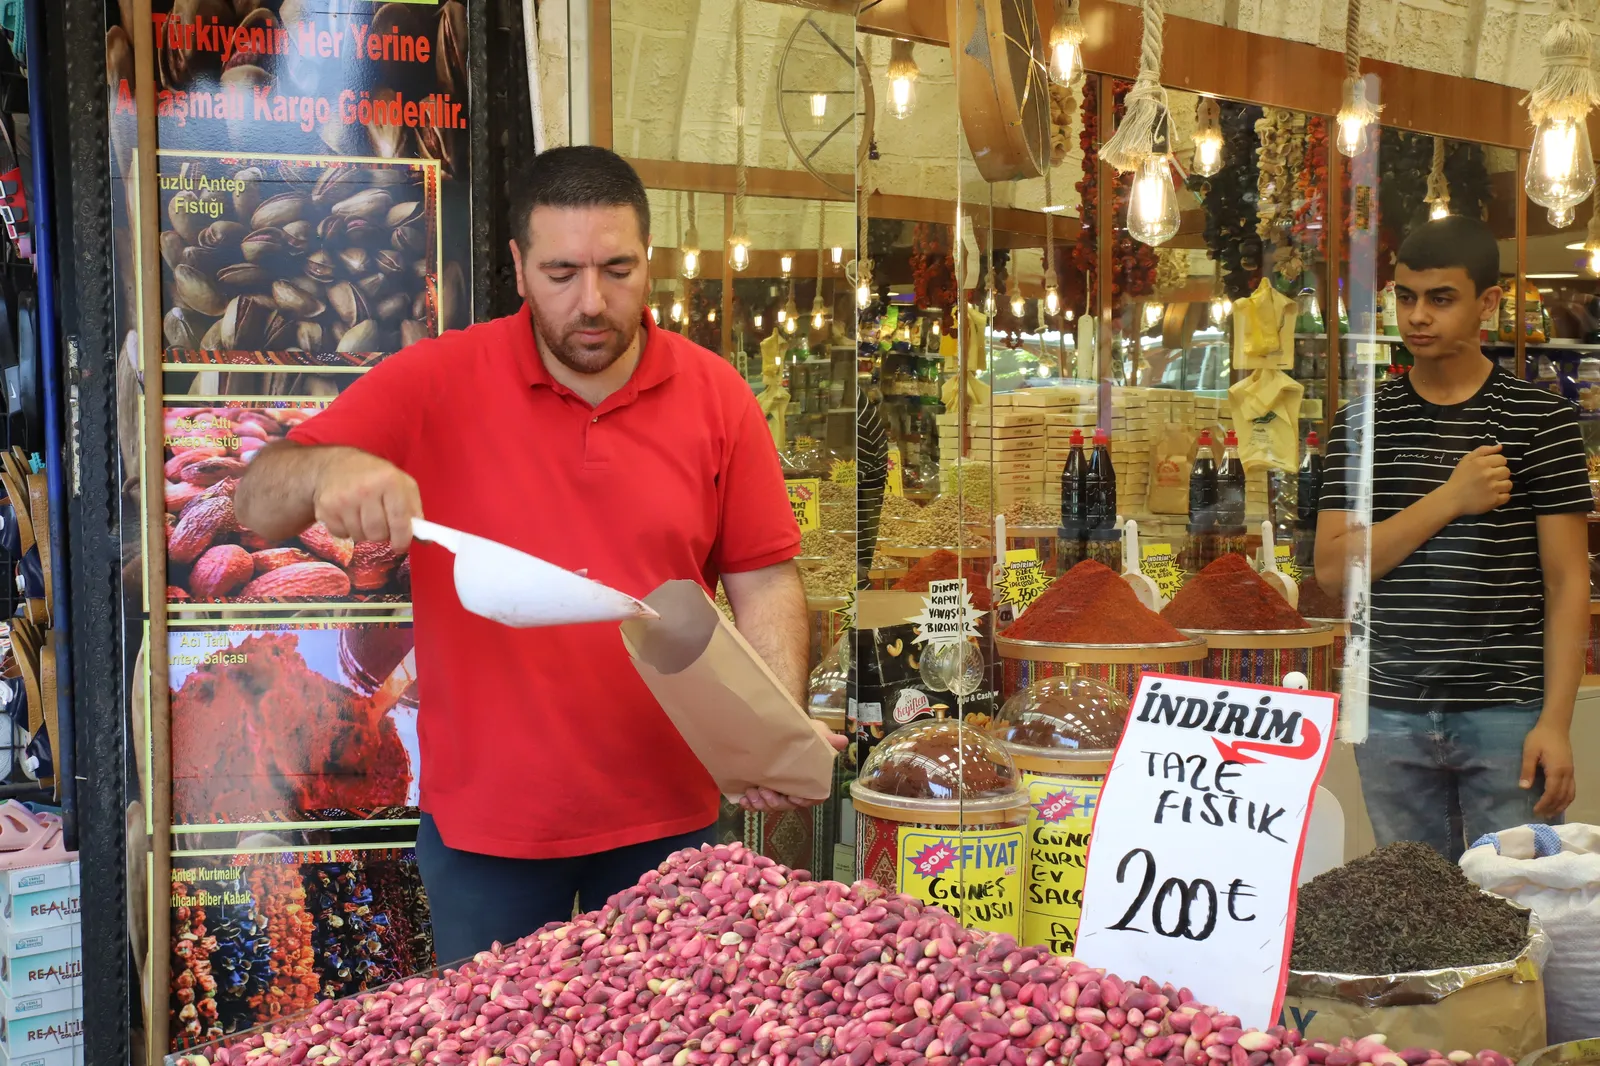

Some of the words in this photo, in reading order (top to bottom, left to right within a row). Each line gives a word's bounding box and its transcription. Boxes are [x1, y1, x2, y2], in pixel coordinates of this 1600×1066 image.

[152, 13, 289, 62] Türkiyenin
[299, 21, 343, 58] Her
[350, 24, 430, 63] Yerine
[253, 85, 331, 132] Kargo
[338, 89, 466, 129] Gönderilir.
[199, 175, 246, 195] Antep
[175, 198, 223, 218] Fıstığı
[174, 417, 208, 432] Ağaç
[209, 417, 231, 429] Altı
[164, 435, 200, 449] Antep
[204, 434, 243, 450] Fıstığı
[932, 583, 964, 593] DİKKA
[180, 634, 201, 648] Acı
[204, 633, 230, 648] Tatlı
[203, 652, 248, 666] Salçası
[1136, 682, 1302, 744] İNDİRİM
[1140, 751, 1247, 795] TAZE
[1043, 796, 1071, 819] ŞOK
[1153, 789, 1288, 843] FISTIK
[920, 847, 950, 873] ŞOK
[961, 838, 1018, 870] FİYAT
[171, 868, 197, 884] Antep
[1031, 864, 1064, 883] EV
[198, 891, 222, 906] Biber
[223, 890, 252, 905] Kabak
